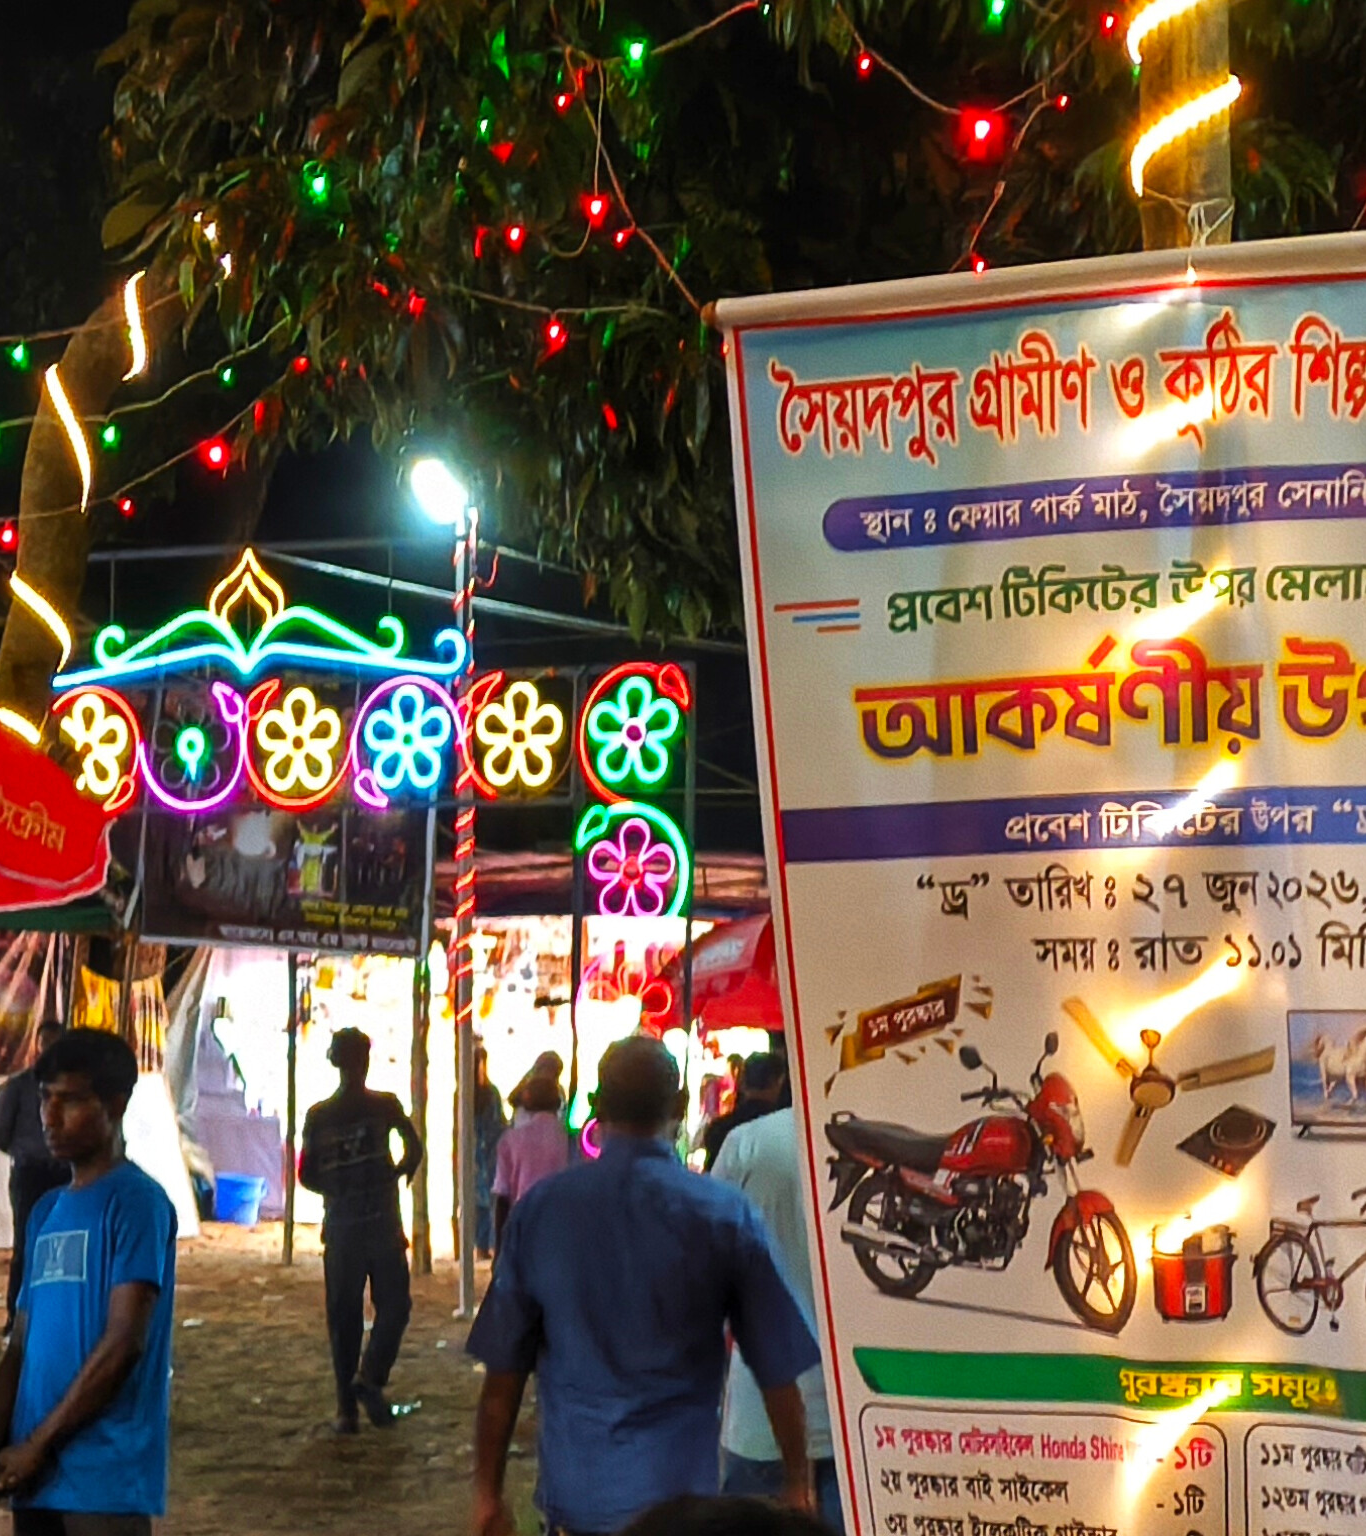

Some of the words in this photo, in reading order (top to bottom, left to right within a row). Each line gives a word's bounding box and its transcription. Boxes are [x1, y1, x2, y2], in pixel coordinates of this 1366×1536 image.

[769, 359, 958, 466] সৈয়দপুর
[971, 330, 1096, 443] গ্রামীণ
[1109, 357, 1145, 419] ও
[859, 507, 911, 545] স্থান
[947, 498, 1021, 535] ফেয়ার
[1031, 482, 1084, 526] পার্ক
[1156, 475, 1268, 517] সৈয়দপুর
[887, 584, 993, 633] প্রবেশ
[1000, 563, 1160, 618] টিকিটের
[855, 633, 1265, 759] আকর্ষণীয়
[1005, 809, 1091, 847] প্রবেশ
[1251, 796, 1317, 836] উপর
[1003, 862, 1094, 913] তারিখ
[1131, 872, 1188, 913] ২৭
[1202, 870, 1259, 917] জুন
[1031, 937, 1097, 973] সময়
[1130, 930, 1208, 973] রাত
[1040, 1432, 1086, 1460] Honda
[962, 1469, 996, 1502] বাই
[997, 1470, 1069, 1506] সাইকেল
